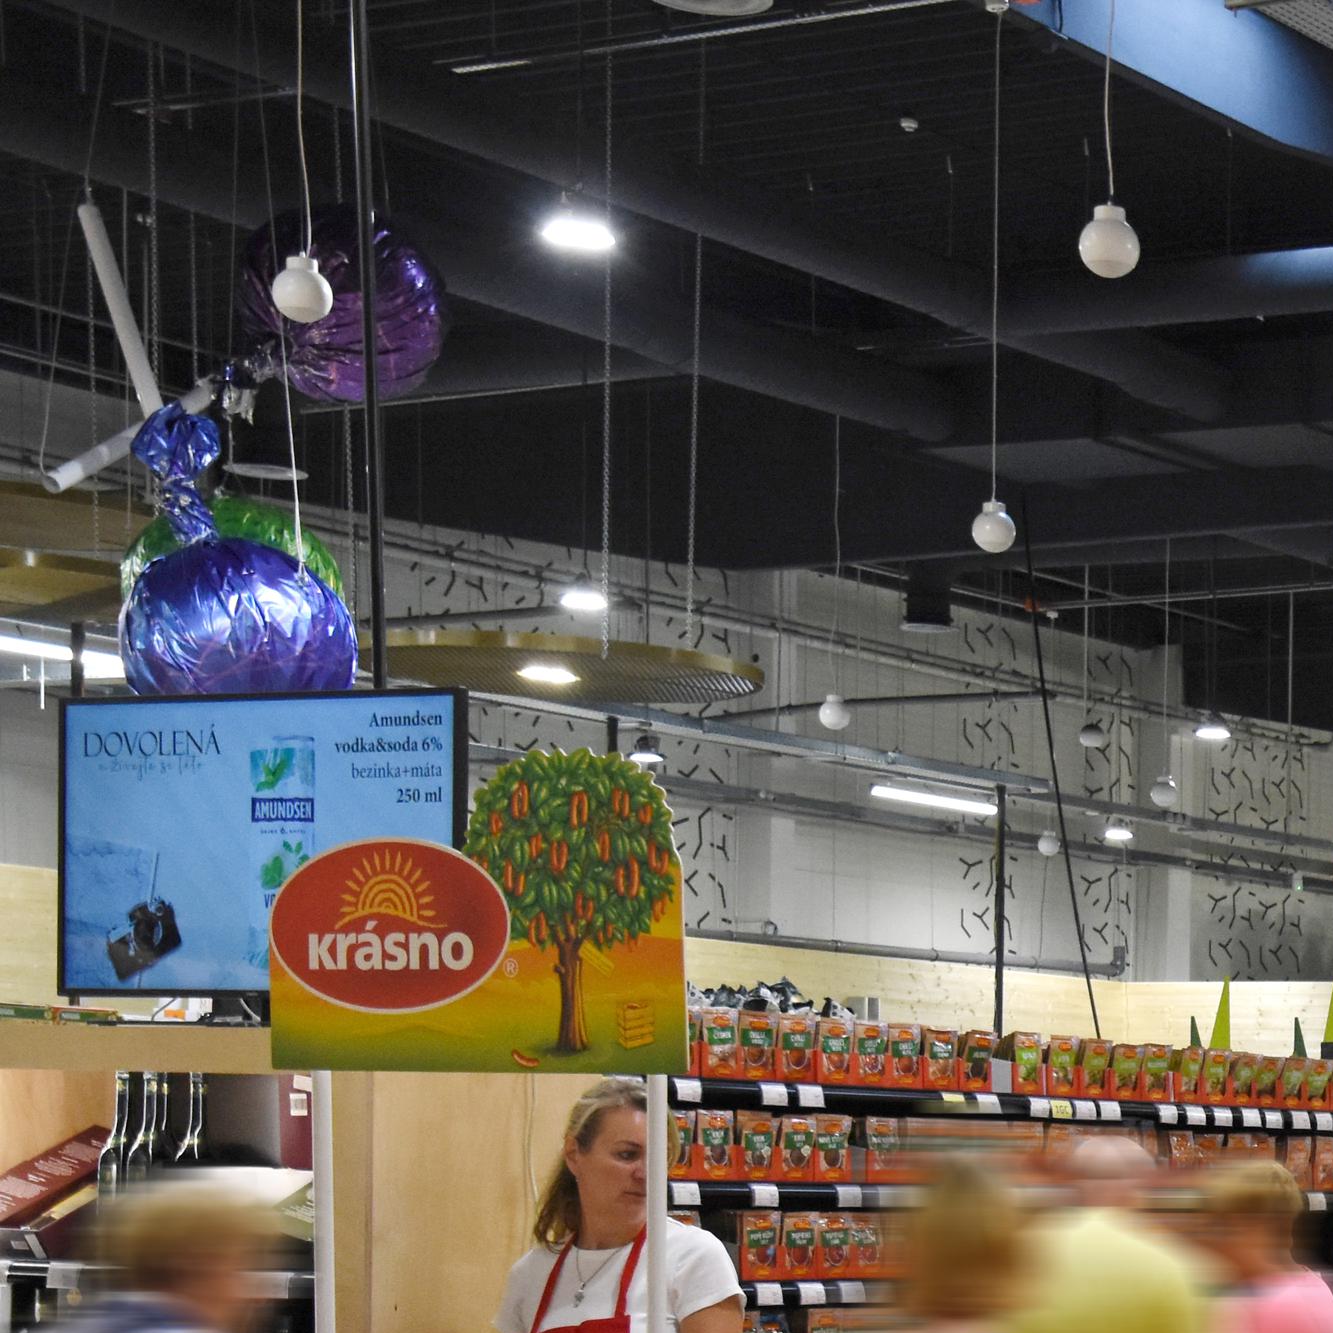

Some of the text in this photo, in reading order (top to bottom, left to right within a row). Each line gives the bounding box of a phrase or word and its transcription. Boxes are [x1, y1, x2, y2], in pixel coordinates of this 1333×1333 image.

[369, 711, 443, 728] Amundsen
[84, 723, 221, 757] DOVOLENÁ
[335, 737, 443, 753] vodka&soda 6%
[351, 763, 442, 779] bezinka+máta
[396, 787, 442, 803] 250 ml
[254, 801, 312, 820] AMUNDSEN
[308, 920, 474, 971] krásno
